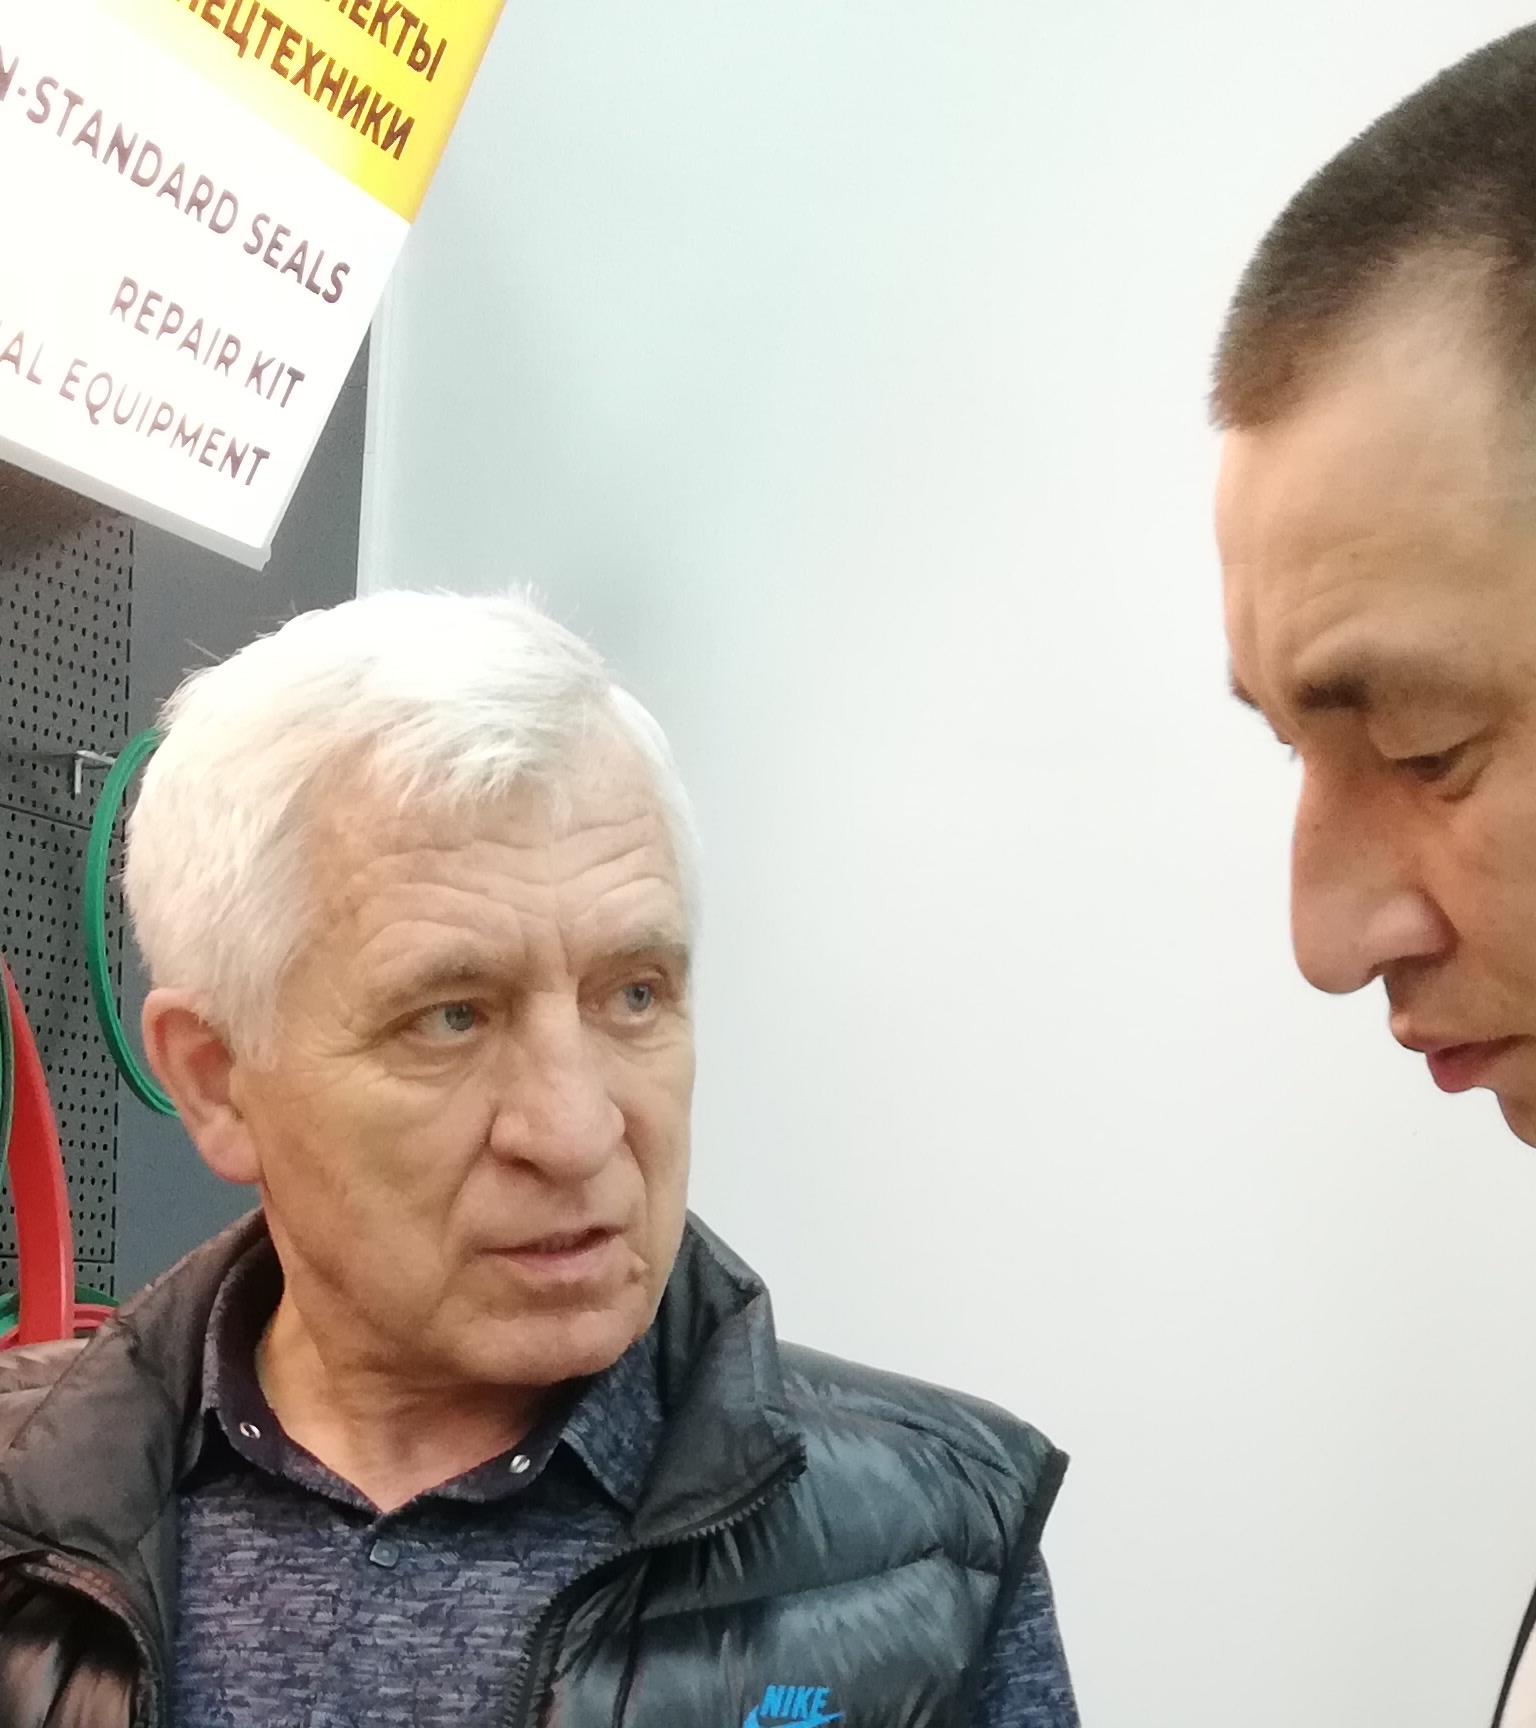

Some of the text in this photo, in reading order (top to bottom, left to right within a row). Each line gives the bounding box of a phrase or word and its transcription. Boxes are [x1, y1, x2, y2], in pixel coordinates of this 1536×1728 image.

[177, 0, 415, 160] ЕЦТЕХНИКИ
[327, 0, 447, 82] ЕКТЫ
[243, 213, 350, 303] SEALS
[110, 276, 305, 408] REPAIR KIT
[59, 358, 270, 486] EQUIPMENT
[759, 1684, 832, 1719] NIKE
